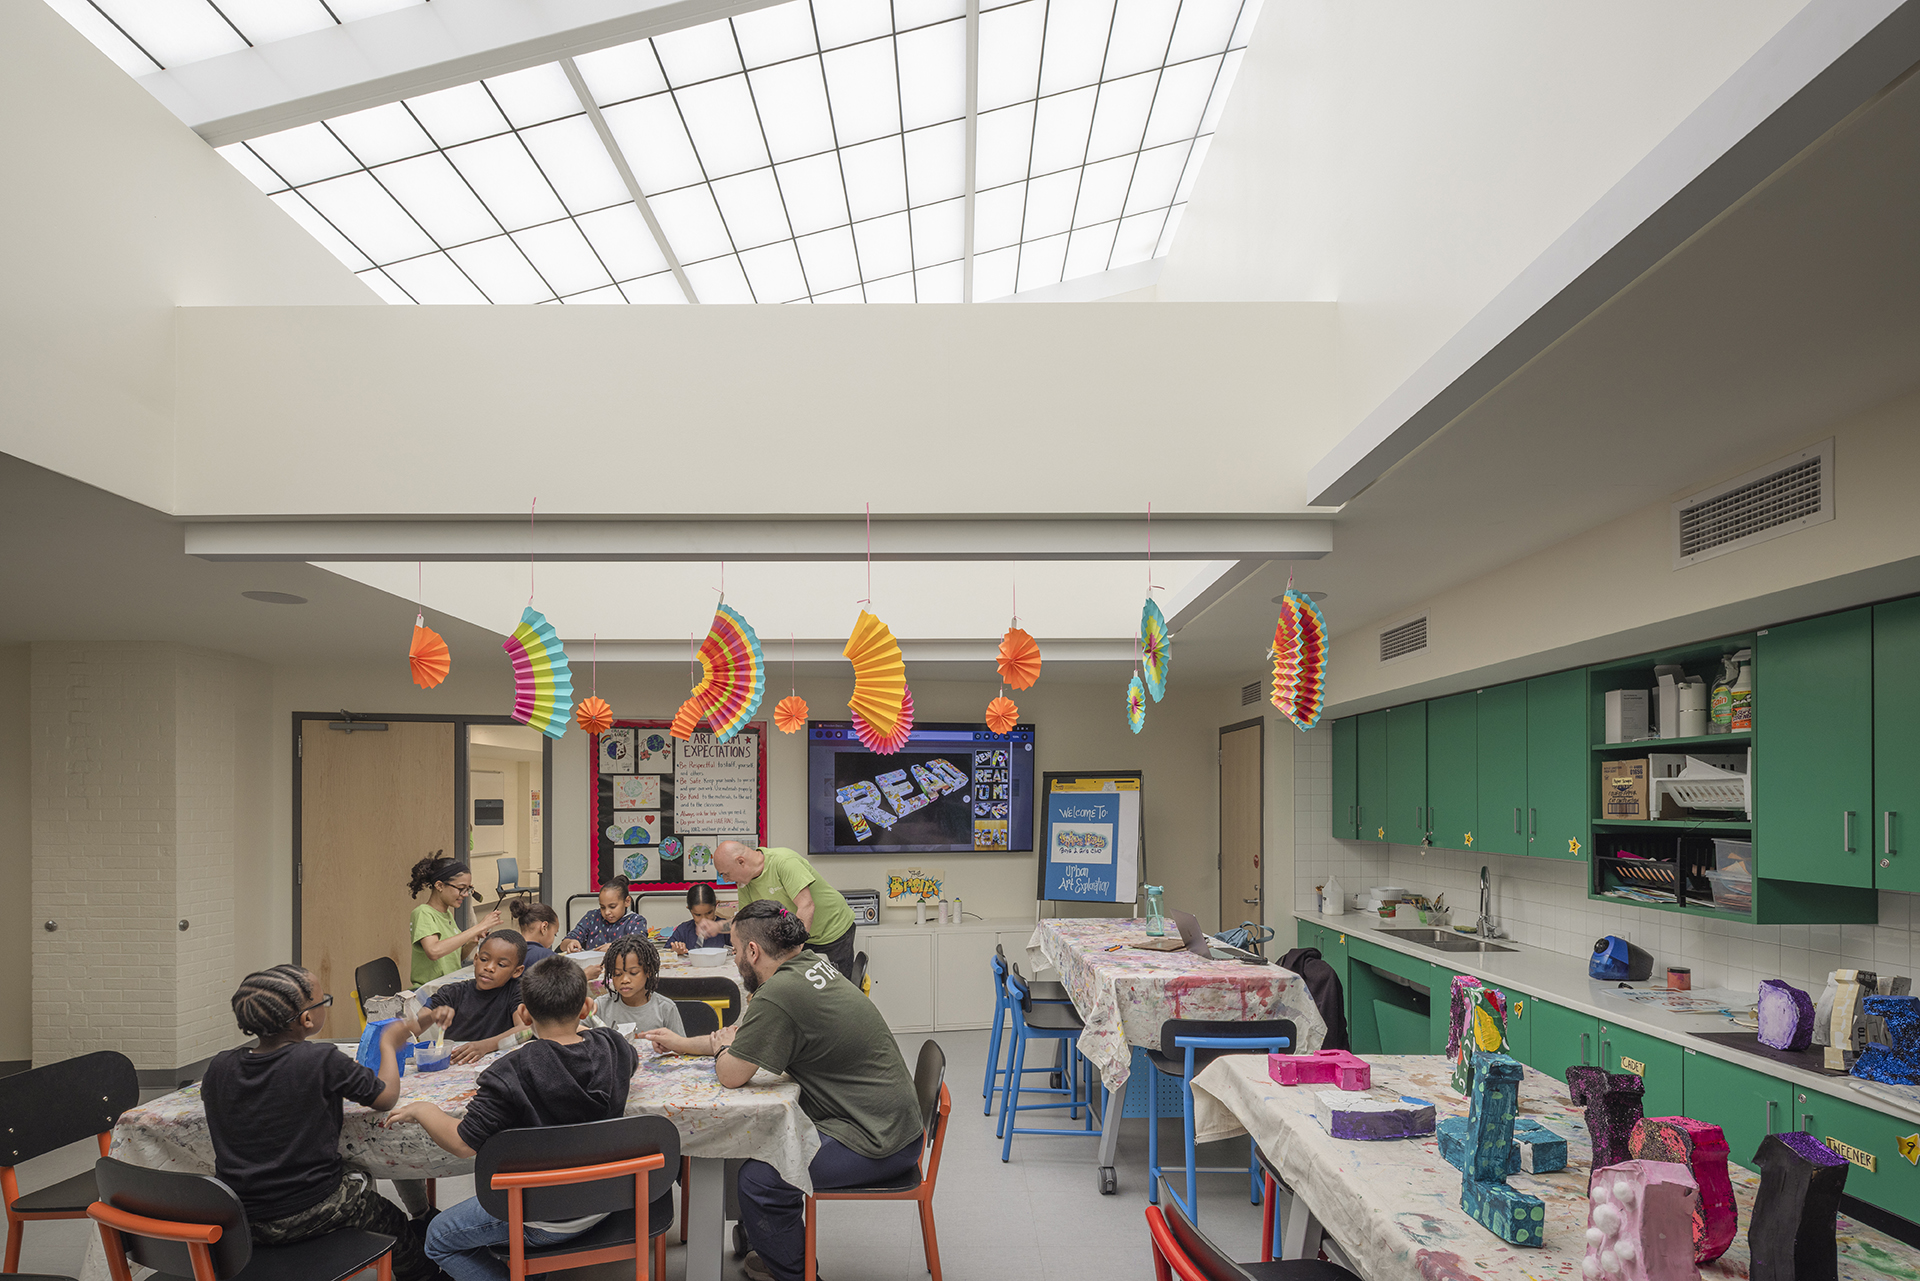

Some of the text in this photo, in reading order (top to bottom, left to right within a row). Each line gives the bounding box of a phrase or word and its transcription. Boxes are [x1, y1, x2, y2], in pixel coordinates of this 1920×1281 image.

[1712, 696, 1727, 708] Gain
[694, 734, 712, 744] ART
[684, 745, 751, 758] EXPECTATIONS
[836, 758, 969, 842] READ
[1058, 878, 1074, 891] Art
[1907, 1142, 1916, 1154] 9
